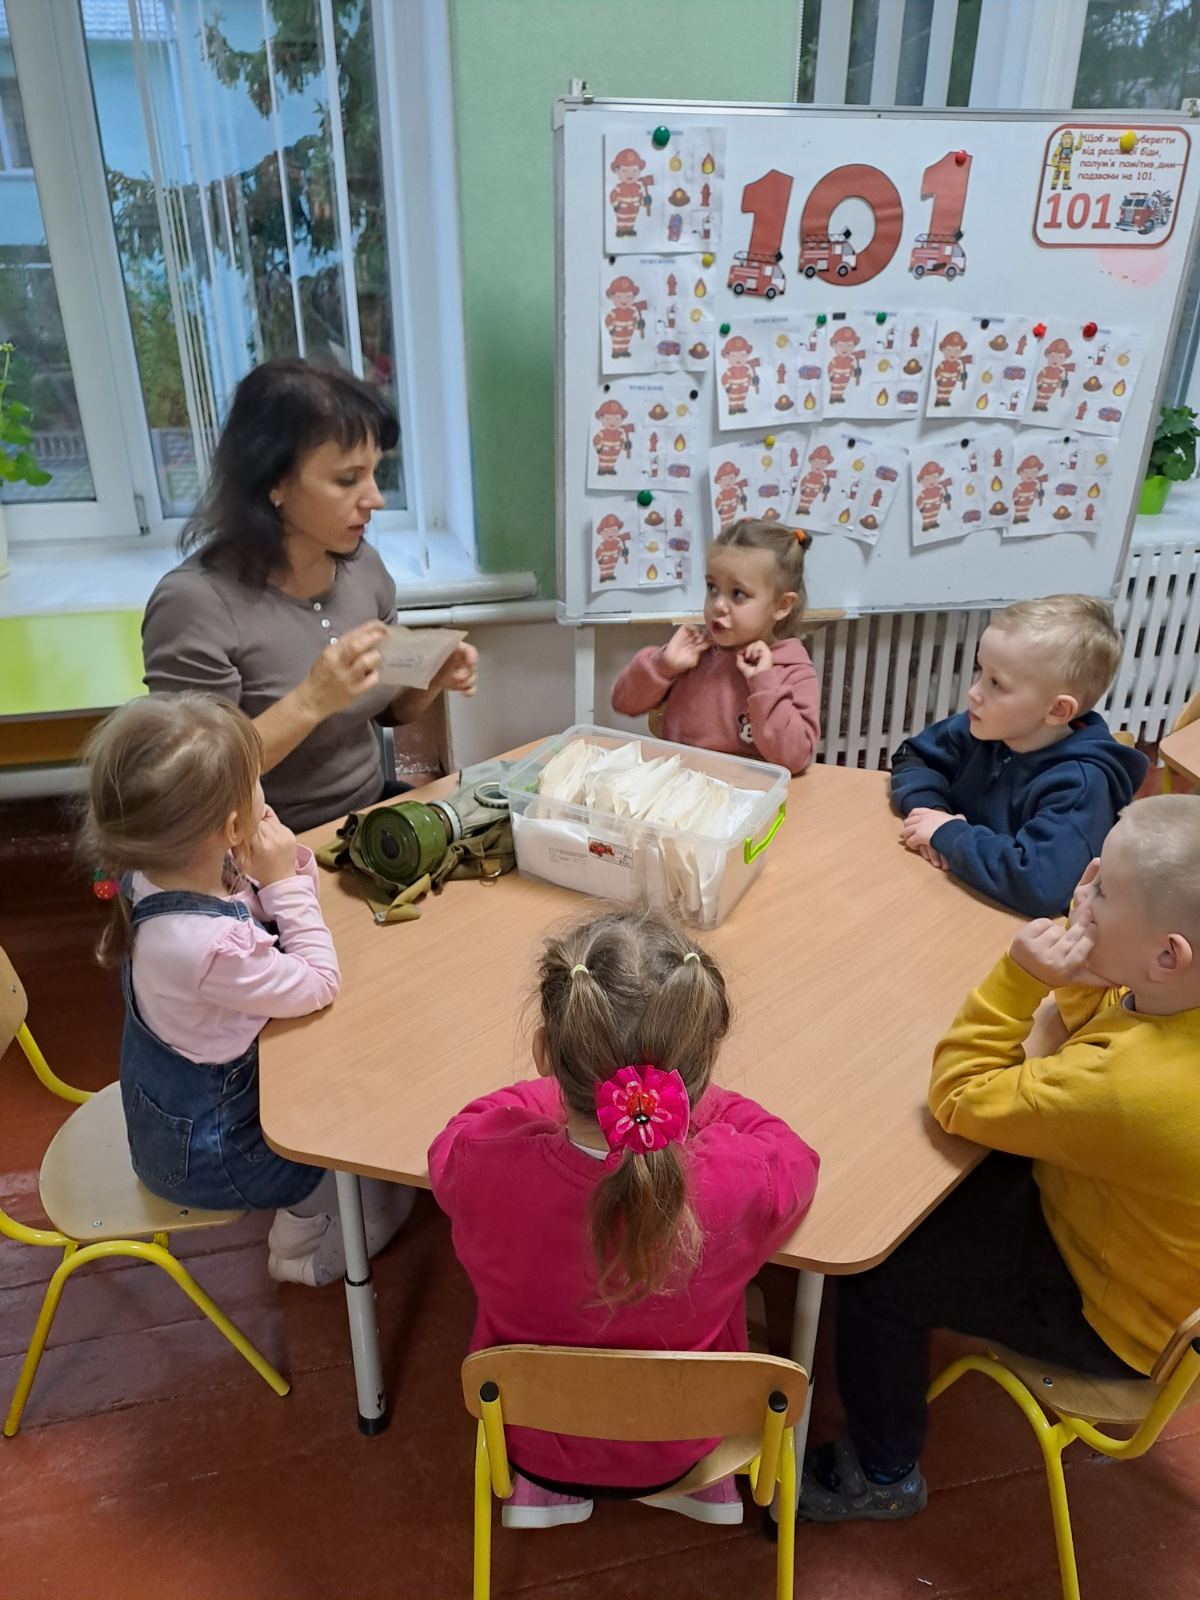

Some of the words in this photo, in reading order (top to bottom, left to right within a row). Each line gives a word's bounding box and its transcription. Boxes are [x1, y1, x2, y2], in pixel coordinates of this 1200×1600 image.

[1122, 173, 1133, 181] на
[735, 151, 973, 293] 101
[1043, 193, 1112, 229] 101
